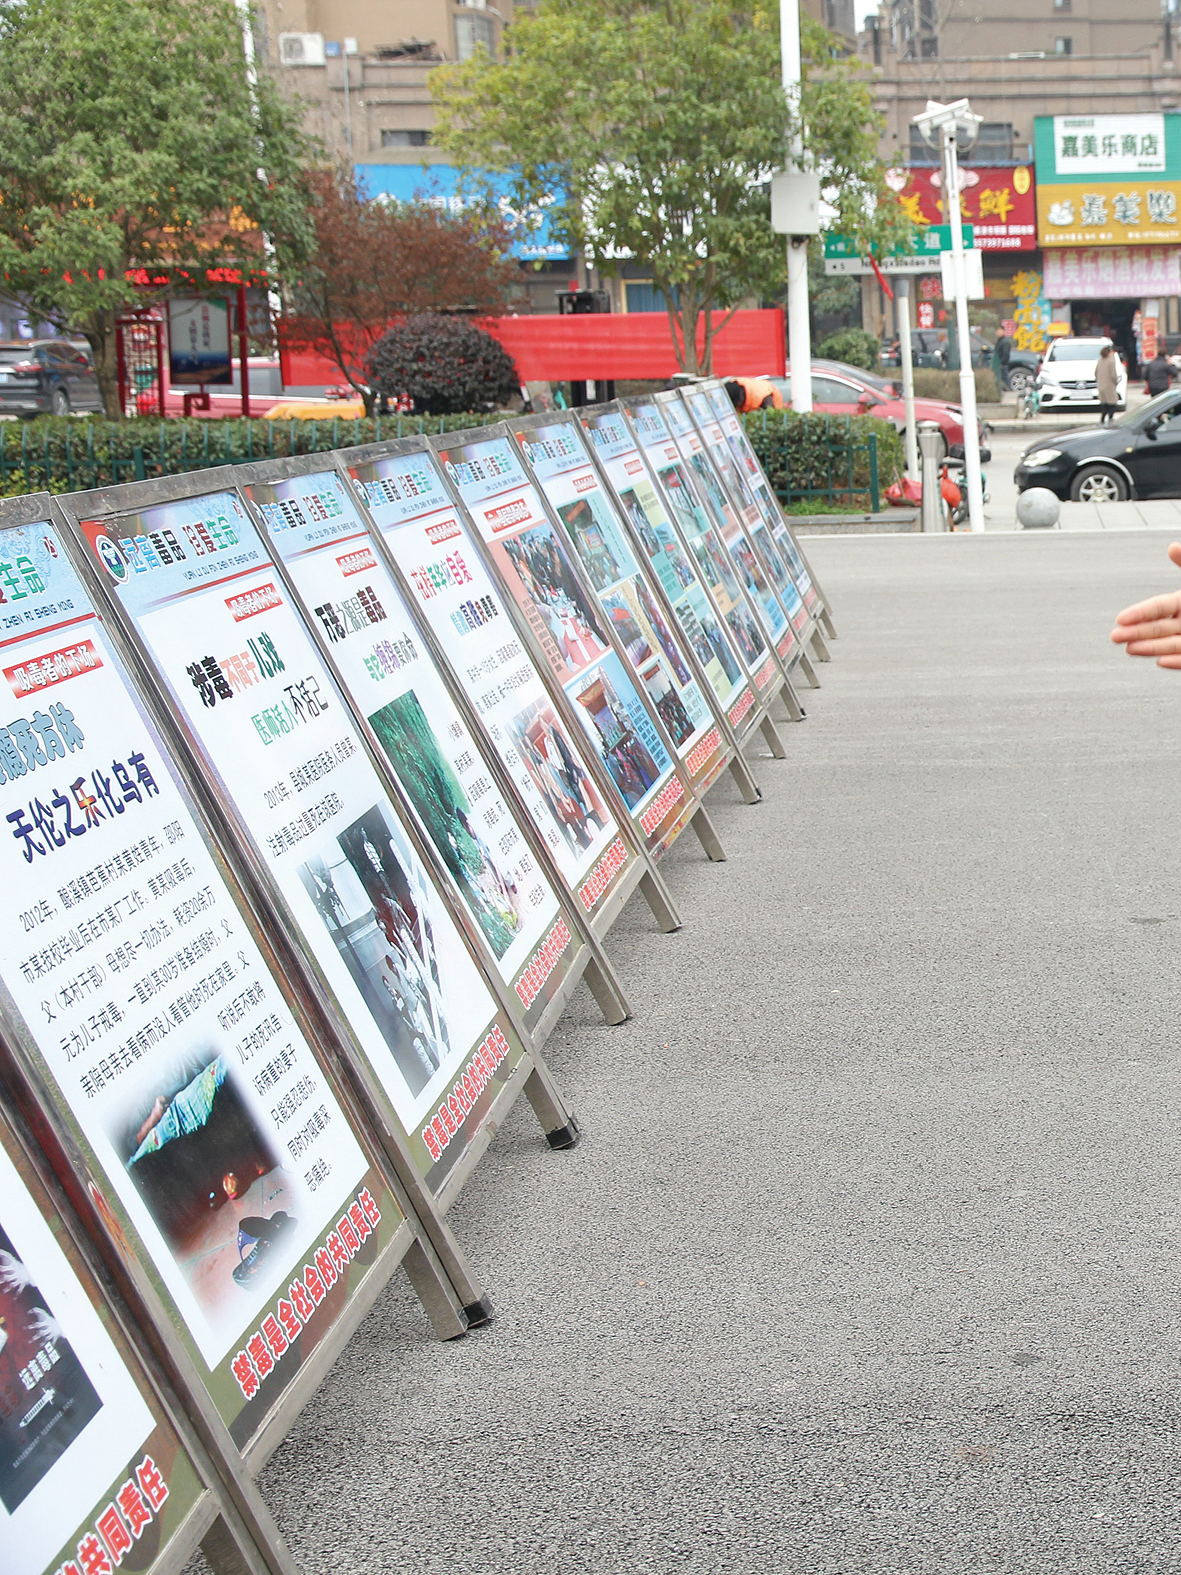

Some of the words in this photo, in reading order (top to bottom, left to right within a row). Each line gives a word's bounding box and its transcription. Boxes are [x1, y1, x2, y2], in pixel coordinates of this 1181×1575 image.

[1061, 133, 1159, 158] 嘉美乐商店
[119, 529, 187, 574] 远离毒品
[182, 516, 239, 557] 珍爱生命
[0, 556, 46, 602] 生命
[231, 588, 276, 617] 吸毒者的下场
[3, 613, 24, 629] ZHEN
[37, 603, 58, 619] SHENG
[316, 586, 385, 643] 万恶之源是毒品
[14, 645, 96, 691] 吸毒者的下场
[185, 632, 285, 707] 涉毒不同于儿戏
[247, 676, 328, 744] 医师活人不活己
[0, 702, 85, 785] 瘾死方休
[6, 750, 160, 864] 天伦之乐化乌有
[513, 917, 572, 1010] 禁毒是全社会的共同责任
[219, 982, 263, 1030] 听说后不敢将
[237, 1013, 280, 1063] 儿子的死讯告
[254, 1044, 297, 1096] 诉病重的妻子
[421, 1024, 510, 1161] 禁毒是全社会的共同责任
[289, 1105, 329, 1160] 同时对吸毒深
[230, 1187, 382, 1400] 禁毒是全社会的共同责任
[19, 1341, 61, 1391] 远离毒品
[54, 1454, 170, 1575] 共同责任
